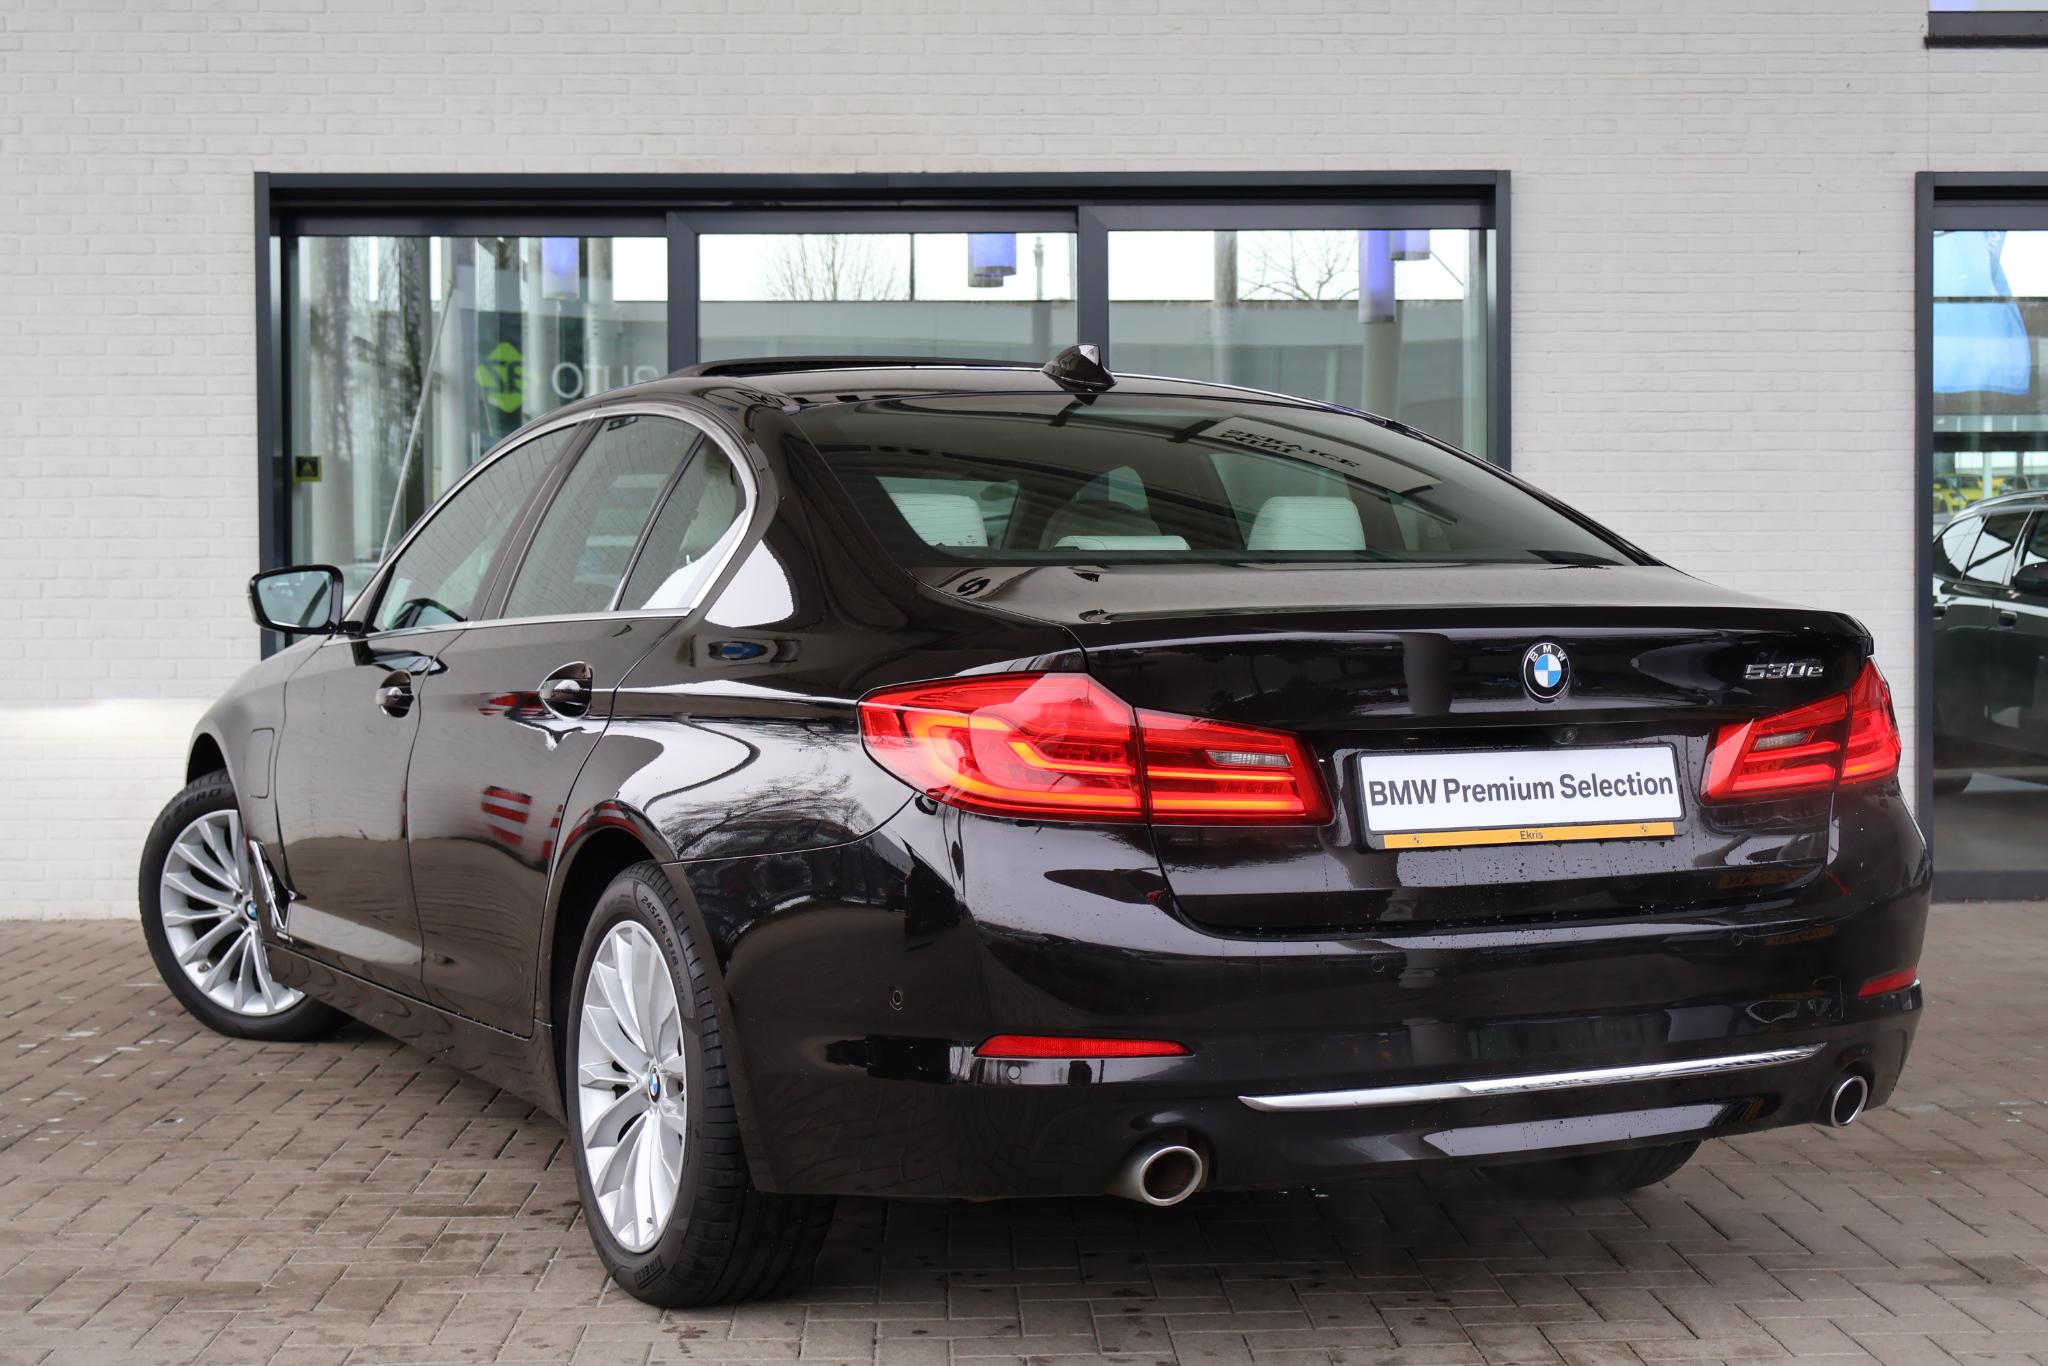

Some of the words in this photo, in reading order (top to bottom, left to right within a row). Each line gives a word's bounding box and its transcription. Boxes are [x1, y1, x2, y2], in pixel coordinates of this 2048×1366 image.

[1744, 663, 1824, 680] 530e
[1369, 779, 1437, 807] BMW
[1444, 776, 1554, 804] Premium
[1560, 772, 1674, 799] Selection
[1519, 830, 1544, 841] Ekris
[641, 895, 667, 935] 245/45
